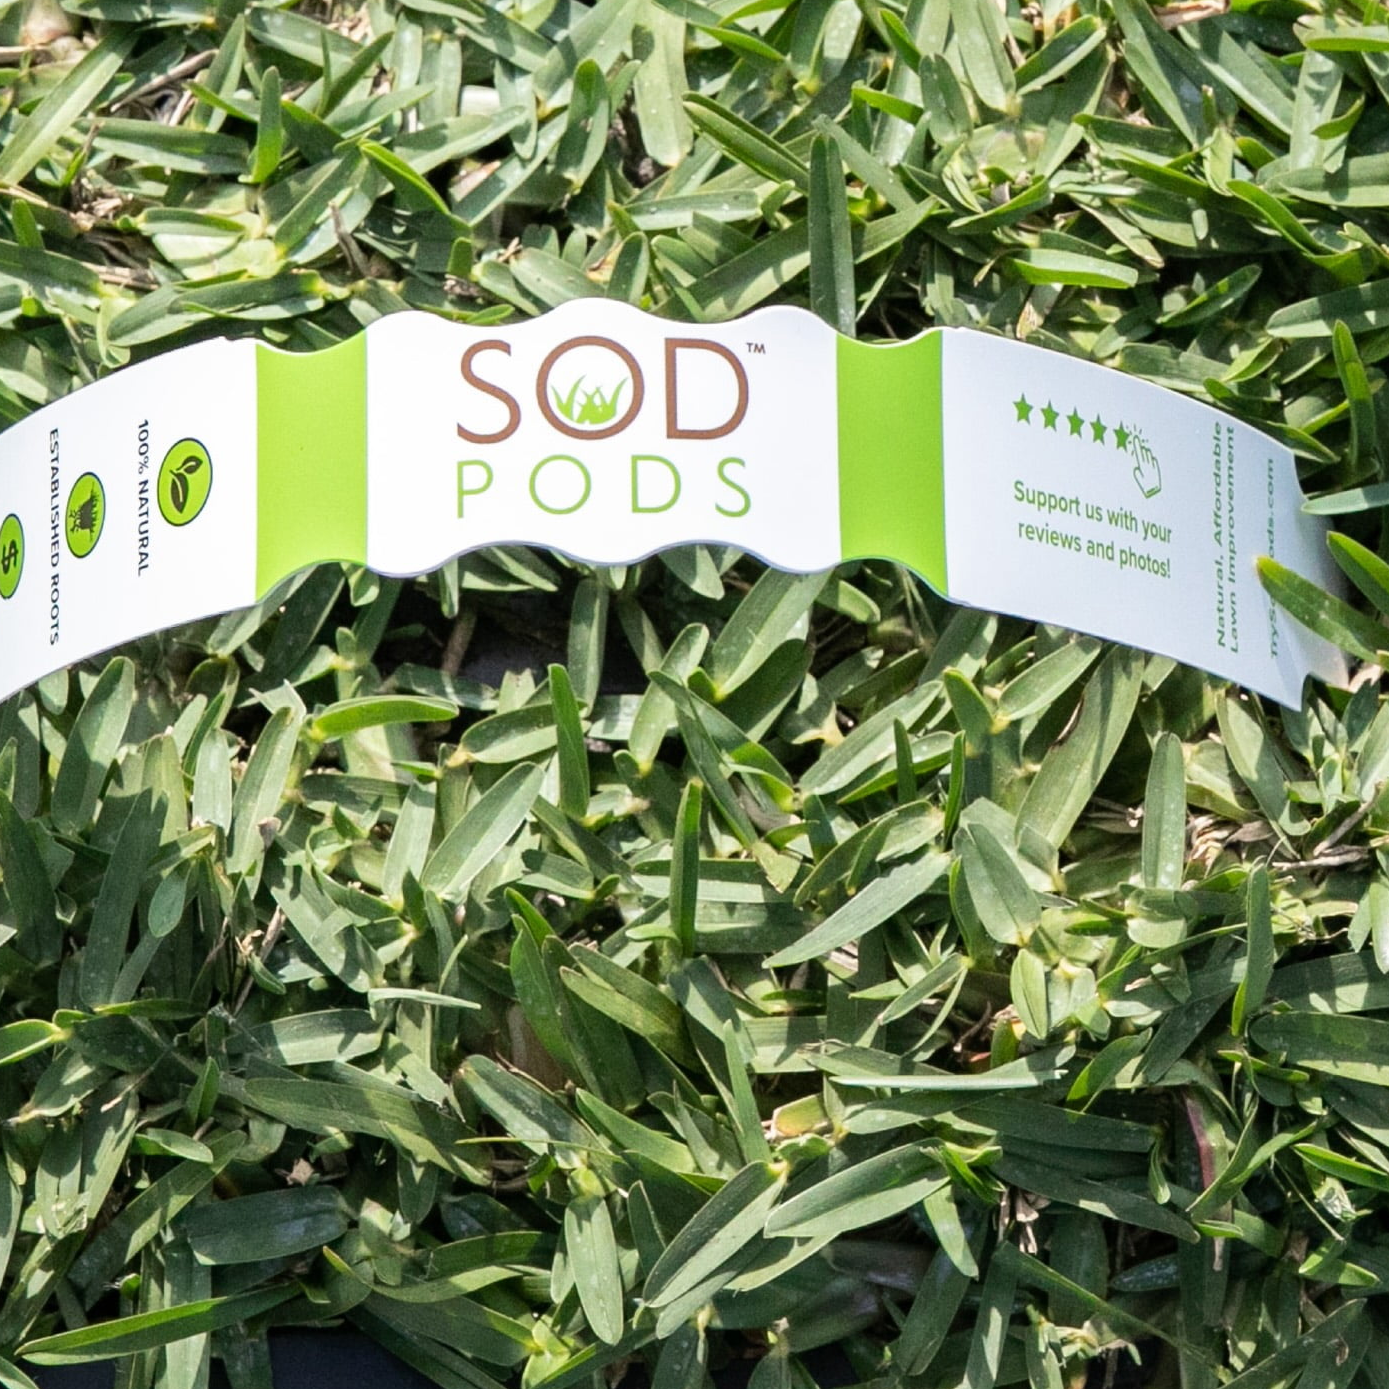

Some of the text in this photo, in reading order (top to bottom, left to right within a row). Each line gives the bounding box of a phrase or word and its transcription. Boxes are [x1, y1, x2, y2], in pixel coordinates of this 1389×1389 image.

[457, 335, 749, 444] SOD
[49, 428, 60, 646] ESTABLISHED ROOTS
[137, 419, 150, 576] 100% NATURAL
[457, 454, 752, 519] PODS
[1013, 480, 1172, 543] Support us with your
[1213, 421, 1223, 547] Affordable
[1226, 426, 1239, 653] Lawn Improvement
[1018, 523, 1171, 579] reviews and photos!
[1267, 458, 1278, 658] TrySoods.com
